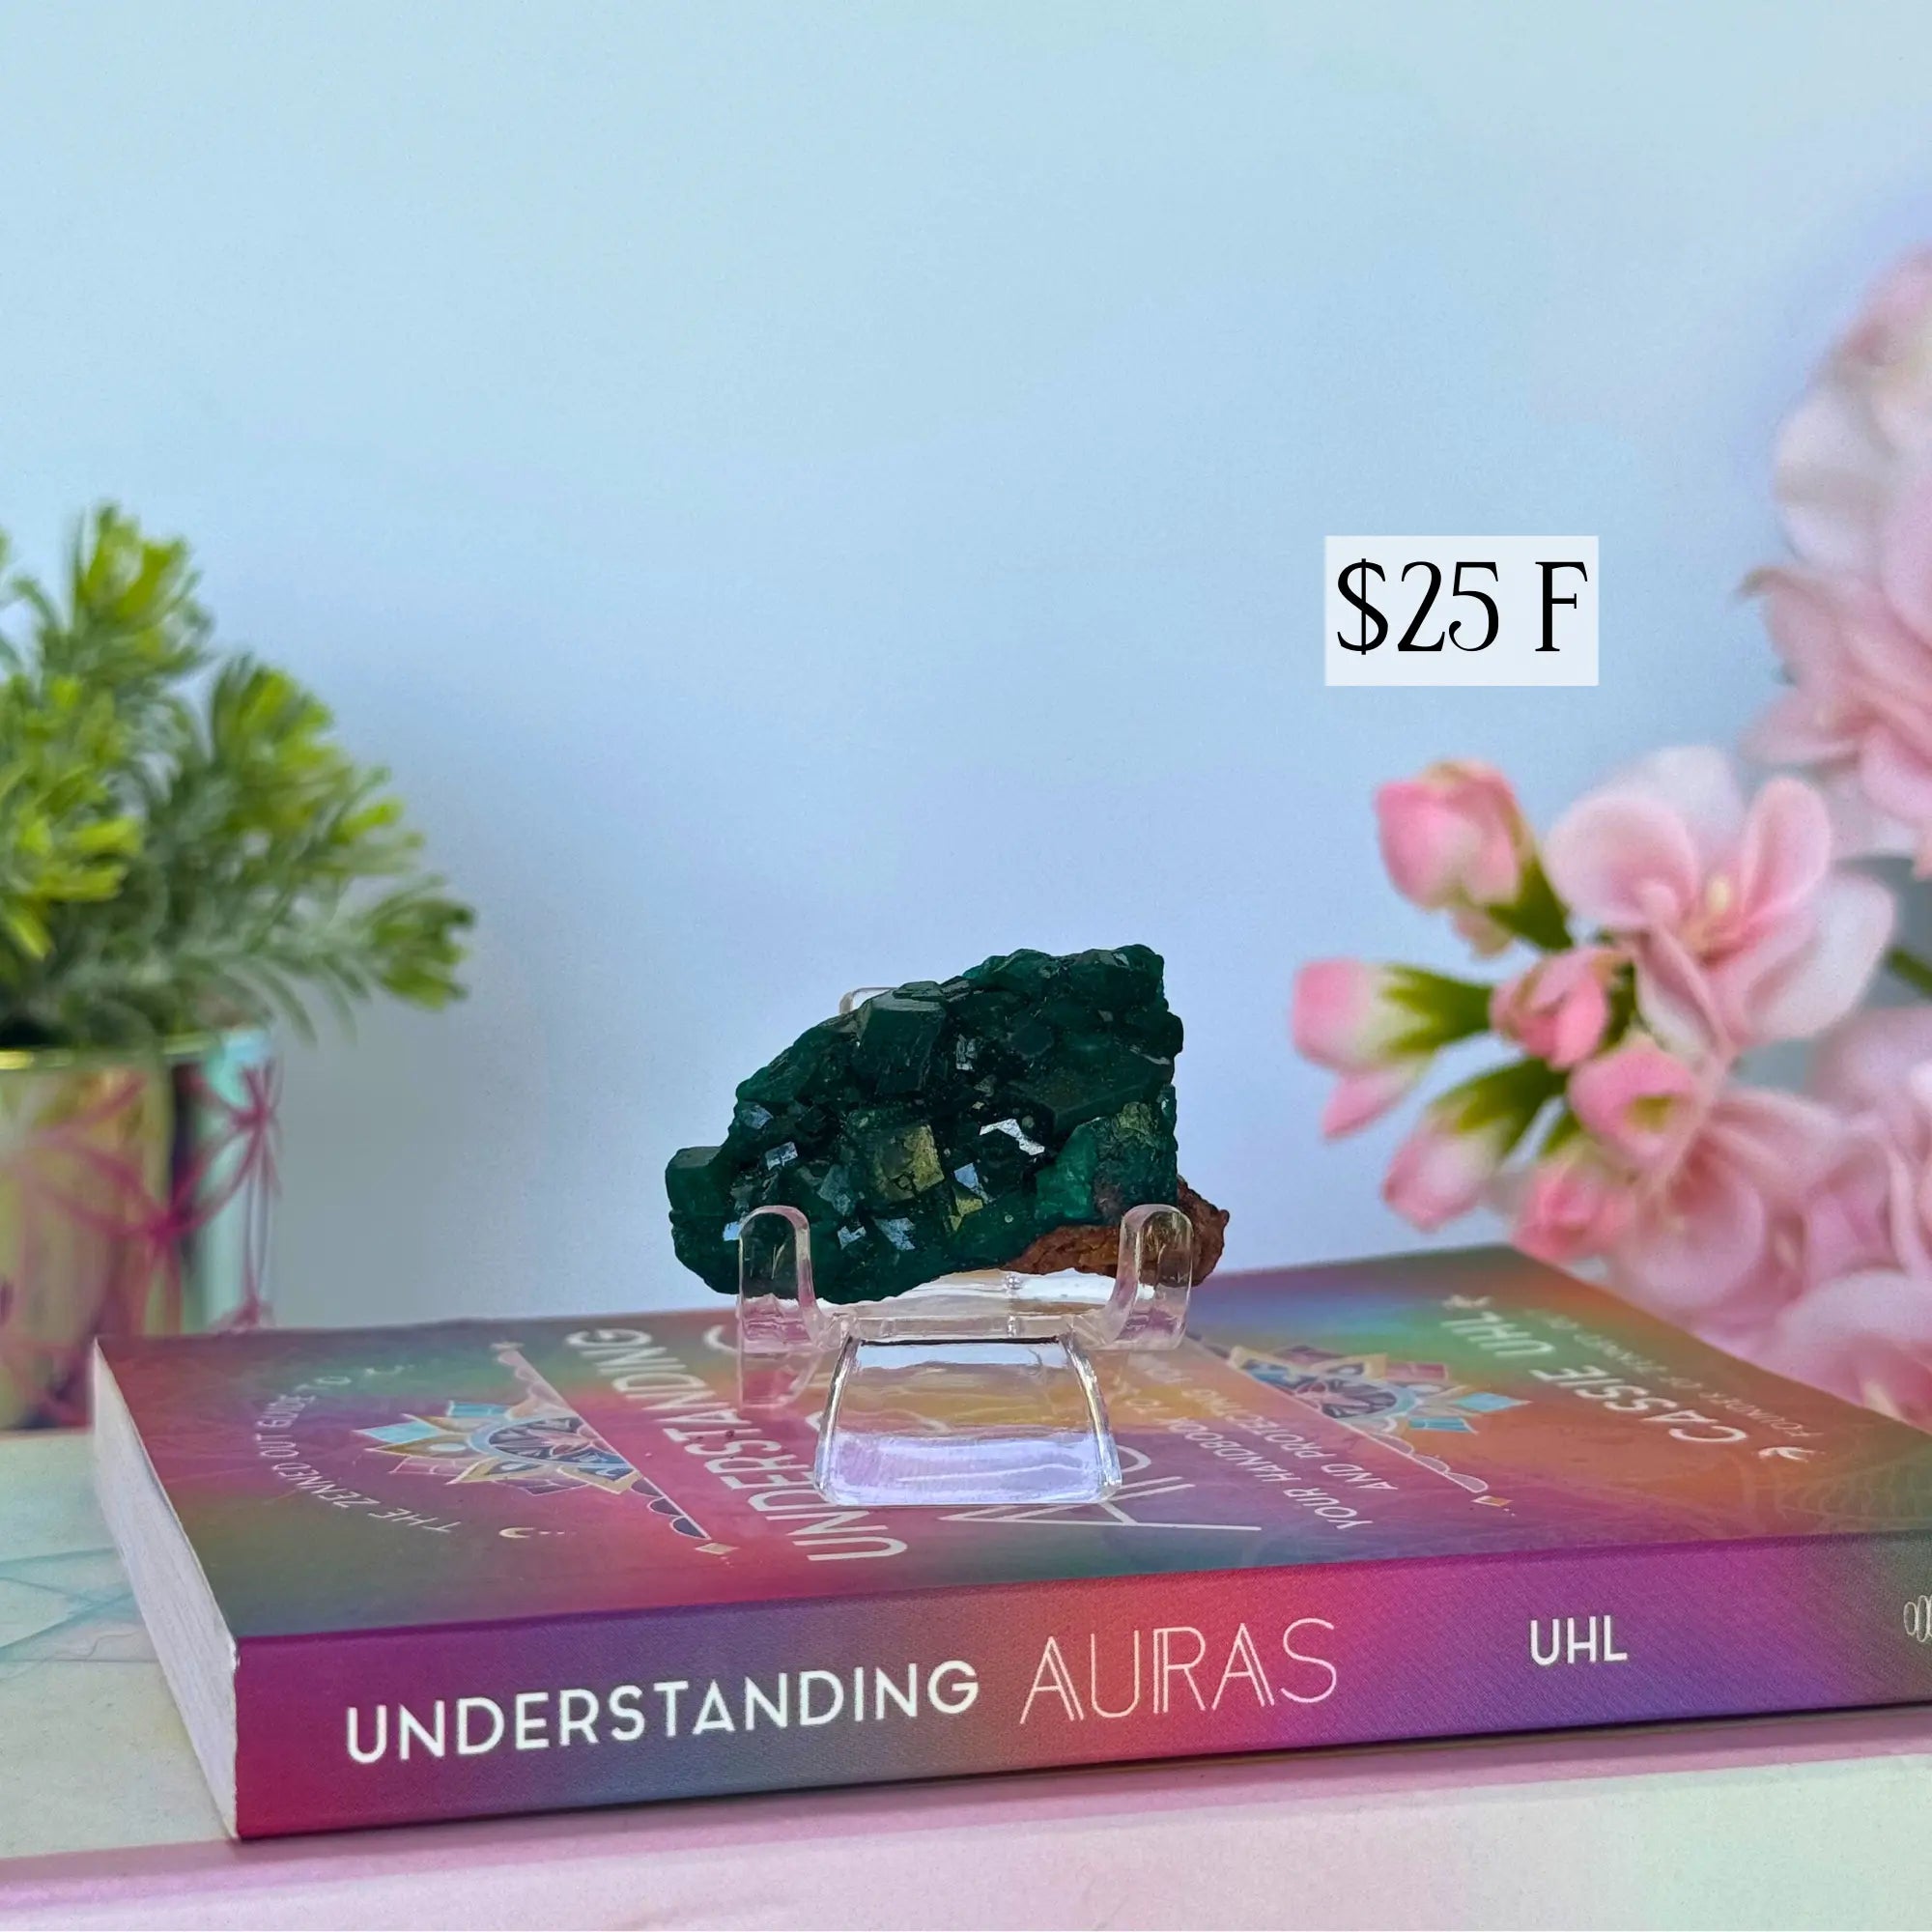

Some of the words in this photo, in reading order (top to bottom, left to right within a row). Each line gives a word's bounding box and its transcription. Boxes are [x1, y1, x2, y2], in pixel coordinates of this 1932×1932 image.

[1440, 1312, 1554, 1356] UHL
[1529, 1365, 1747, 1442] CASSIE
[255, 1434, 299, 1458] OUT
[564, 1328, 908, 1561] UNDERSTANDING
[1154, 1417, 1301, 1482] HANDBOOK
[272, 1463, 380, 1507] ZENNED
[1321, 1463, 1398, 1491] AND
[368, 1508, 461, 1532] THE
[1283, 1488, 1373, 1529] YOUR
[346, 1660, 980, 1765] UNDERSTANDING
[1019, 1617, 1338, 1725] AURAS
[1529, 1614, 1628, 1666] UHL
